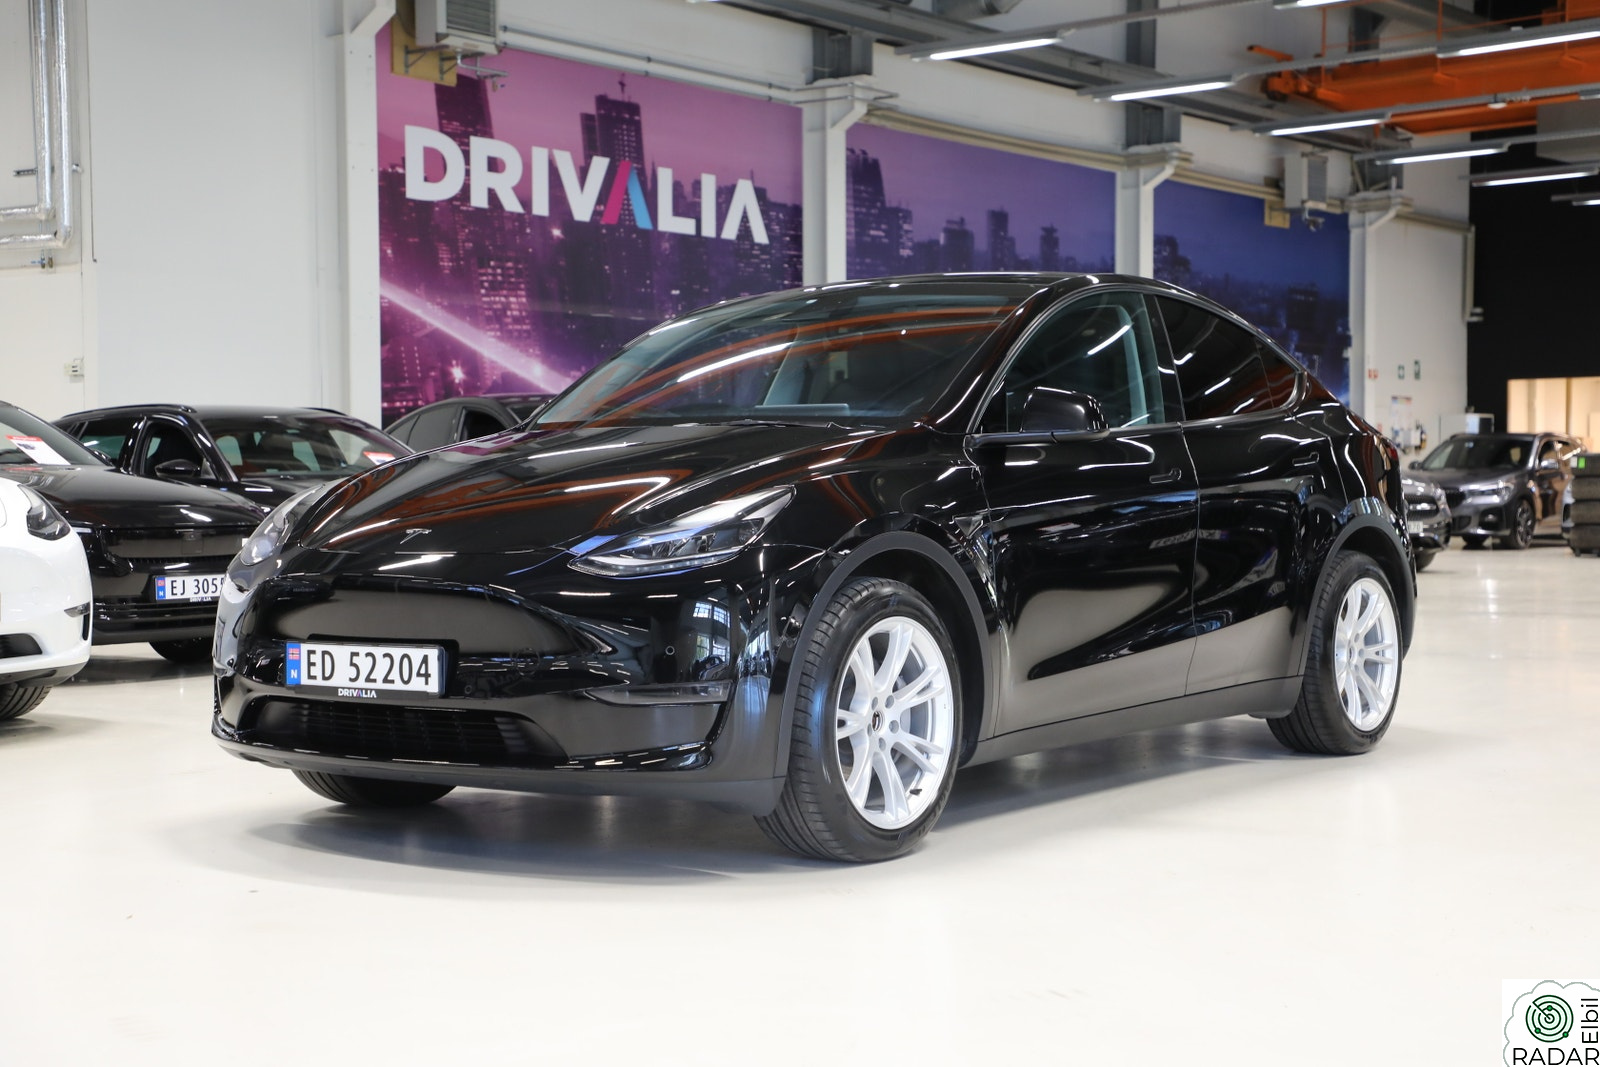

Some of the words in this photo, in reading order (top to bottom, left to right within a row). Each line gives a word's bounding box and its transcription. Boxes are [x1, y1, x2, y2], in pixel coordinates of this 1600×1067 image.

[404, 124, 770, 245] DRIVALIA
[171, 580, 185, 596] EJ
[290, 669, 298, 679] N
[306, 649, 335, 681] ED
[348, 651, 431, 686] 52204
[338, 688, 377, 698] DRIVALIA
